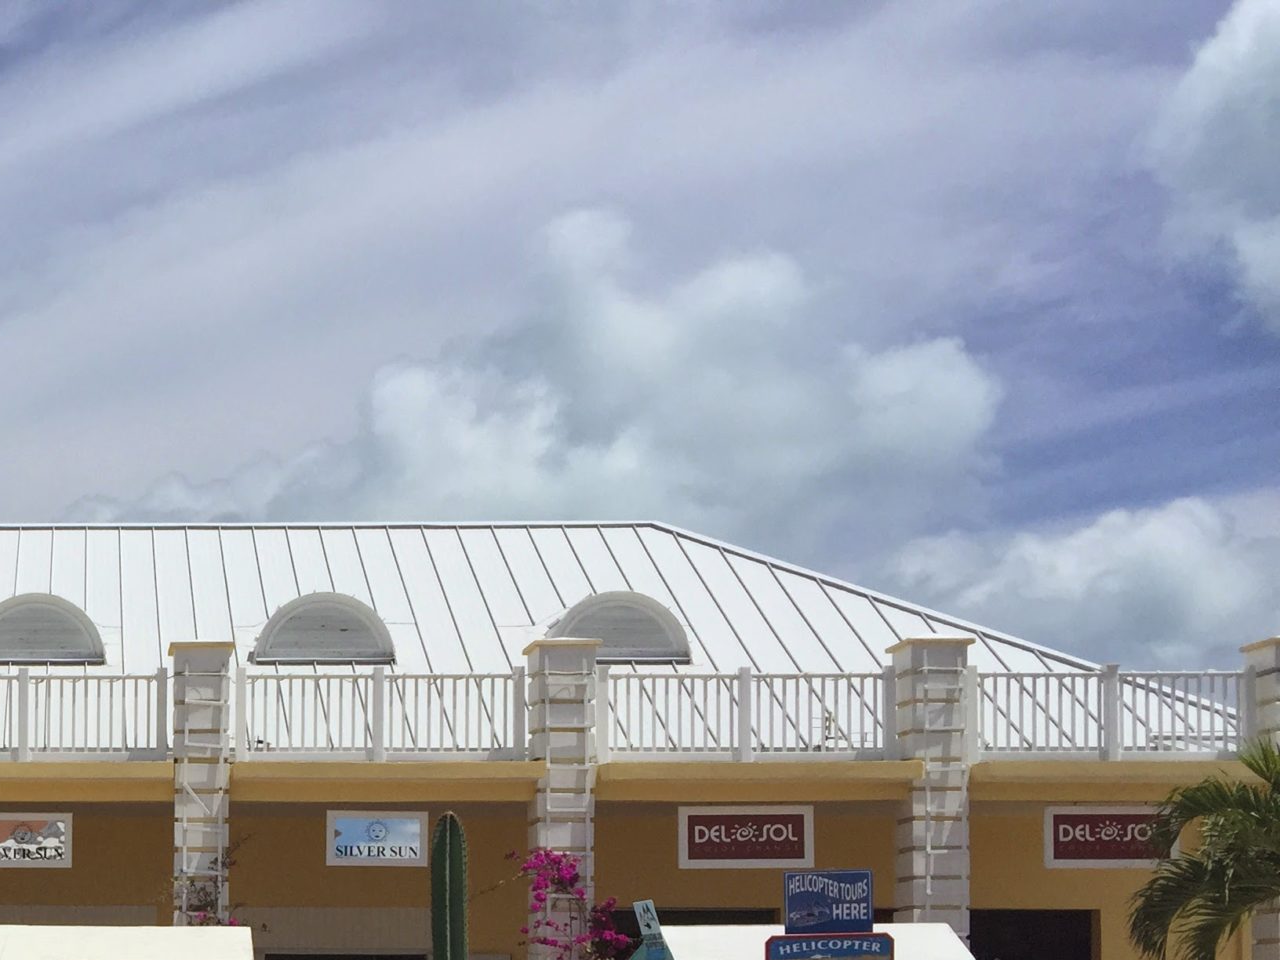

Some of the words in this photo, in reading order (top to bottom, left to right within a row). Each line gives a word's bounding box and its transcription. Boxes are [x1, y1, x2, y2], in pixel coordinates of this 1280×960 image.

[694, 825, 731, 843] DEL
[758, 824, 798, 841] SOL
[1058, 824, 1096, 842] DEL
[1123, 823, 1156, 841] SO
[35, 846, 64, 860] SUN
[335, 845, 386, 857] SILVER
[389, 846, 419, 858] SUN
[788, 874, 840, 899] HELICOPTER
[840, 878, 868, 901] TOURS
[832, 902, 868, 920] HERE
[779, 939, 881, 955] HELICOPTER
